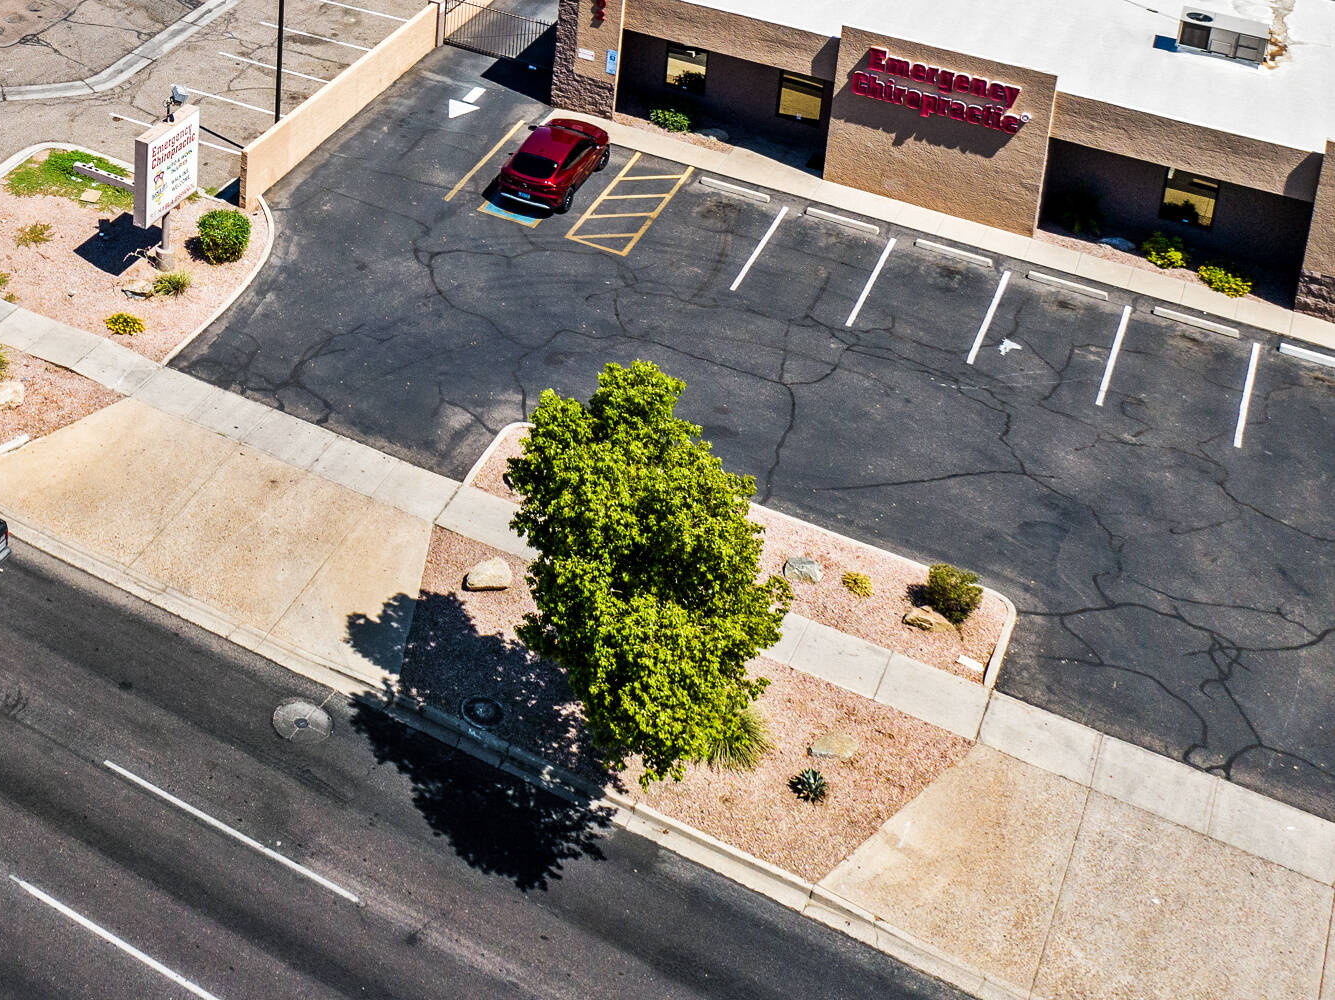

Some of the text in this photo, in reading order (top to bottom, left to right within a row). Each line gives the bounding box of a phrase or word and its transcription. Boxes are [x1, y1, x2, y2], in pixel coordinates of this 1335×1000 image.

[868, 45, 1022, 110] Emergency
[152, 123, 193, 158] Emergency
[152, 132, 196, 169] Chiropractic
